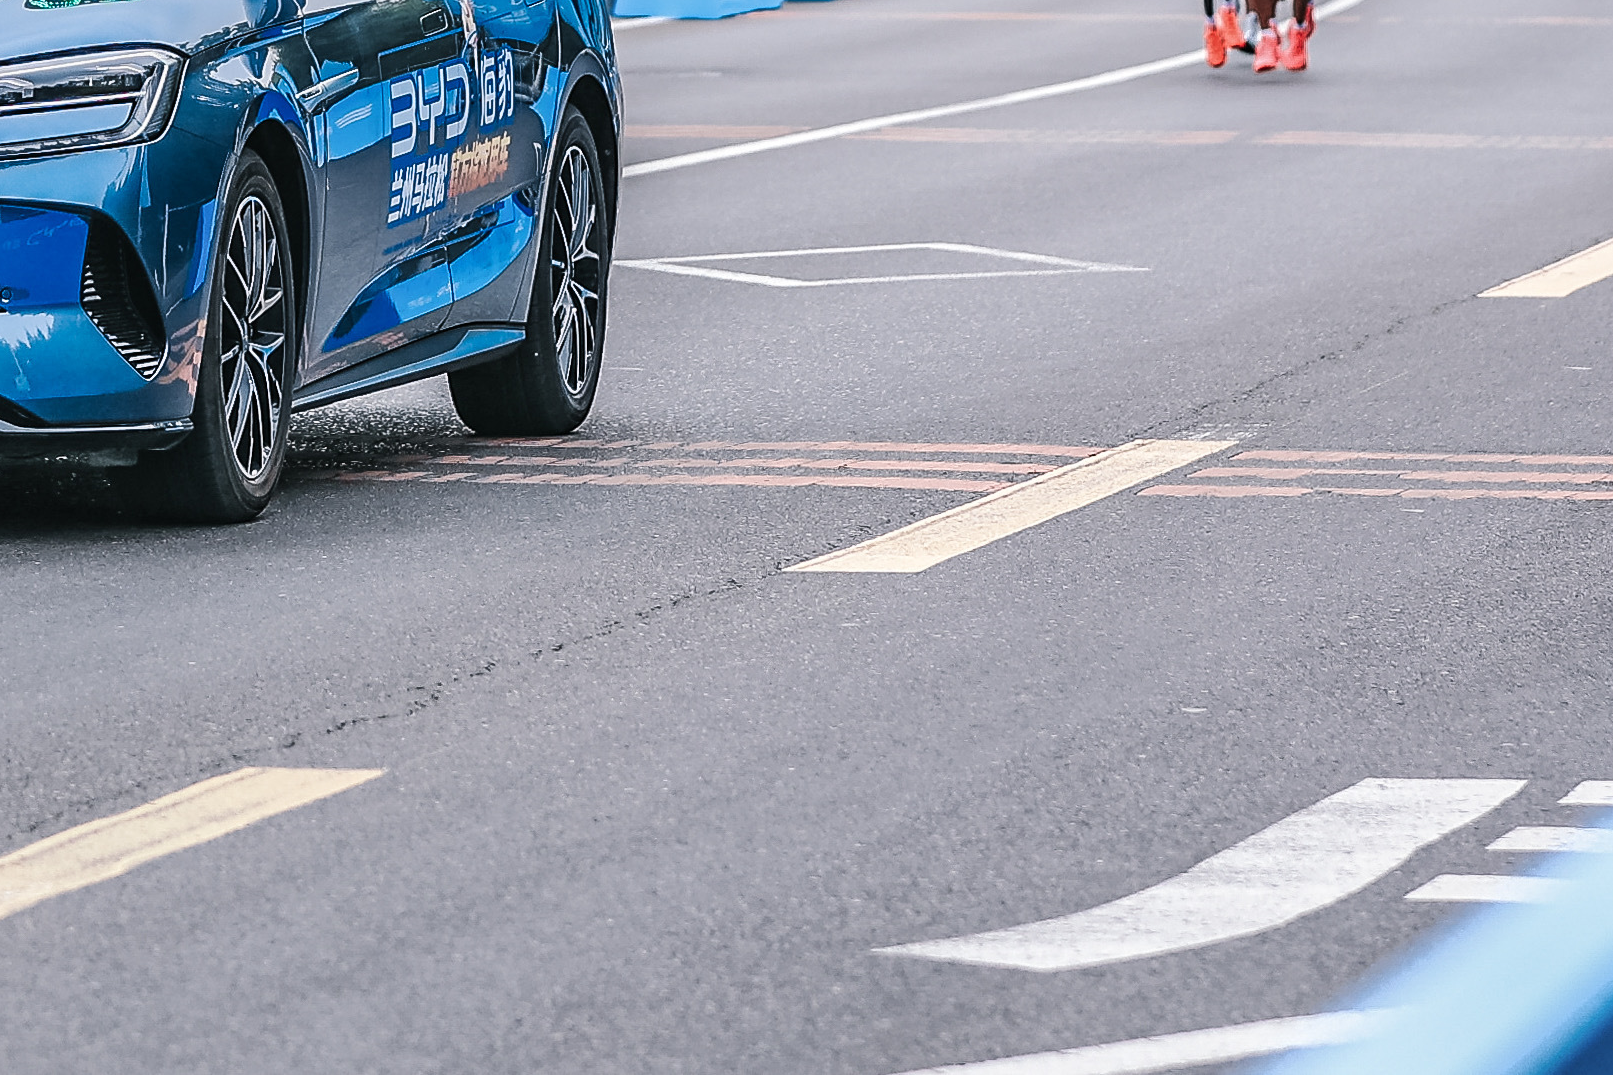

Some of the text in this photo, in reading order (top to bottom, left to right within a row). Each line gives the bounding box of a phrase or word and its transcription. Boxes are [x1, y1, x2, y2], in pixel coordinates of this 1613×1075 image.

[391, 45, 514, 158] BYD 海豹
[387, 152, 448, 224] 兰州马拉松
